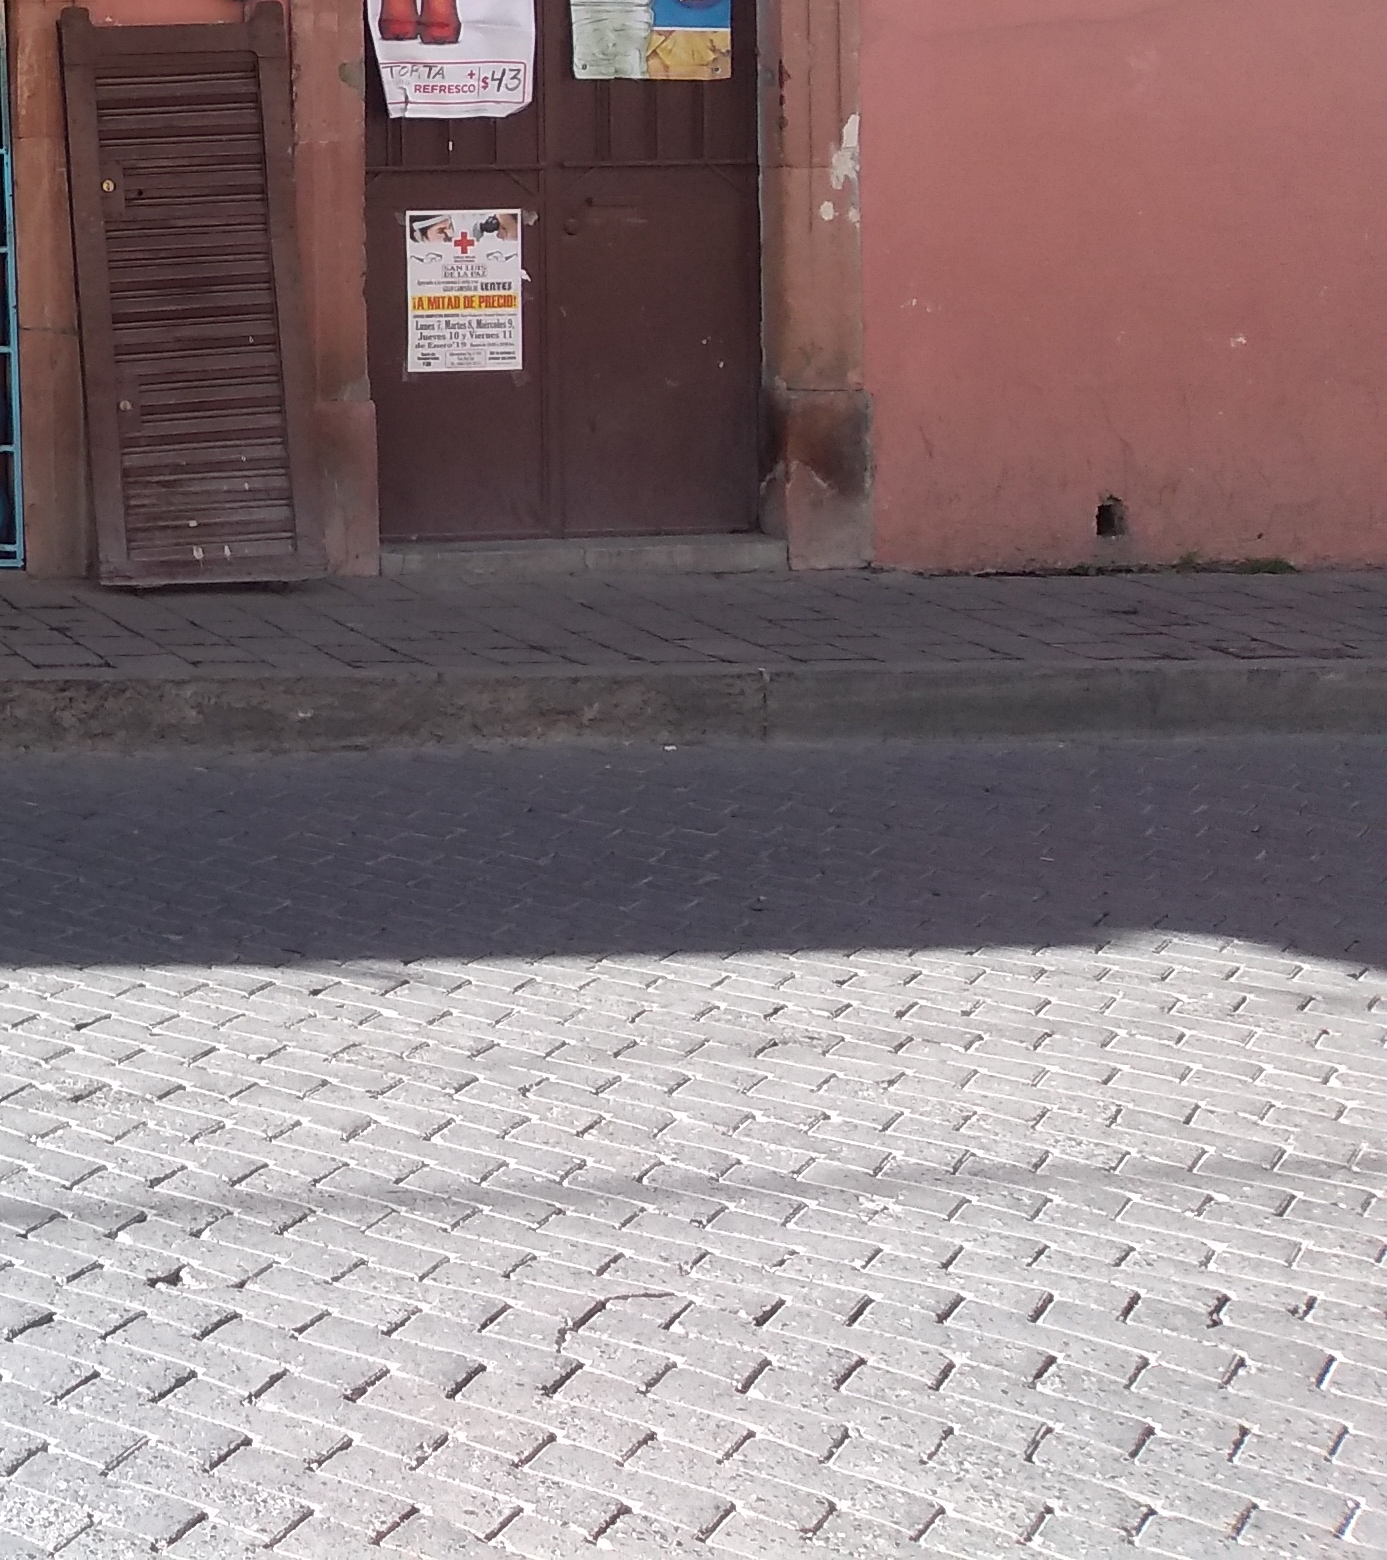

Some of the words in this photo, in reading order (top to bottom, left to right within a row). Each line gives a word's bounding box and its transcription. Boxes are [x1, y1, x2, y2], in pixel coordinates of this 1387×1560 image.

[382, 64, 446, 80] TORTA
[414, 84, 476, 94] REFRESCO
[427, 295, 461, 310] MITAD
[463, 295, 476, 309] DE
[478, 294, 517, 309] PRECIO!
[445, 319, 467, 330] Martes
[418, 331, 447, 341] Jueves
[449, 331, 460, 340] 10
[461, 333, 467, 342] y
[469, 330, 500, 339] Viernes
[502, 330, 513, 339] 11
